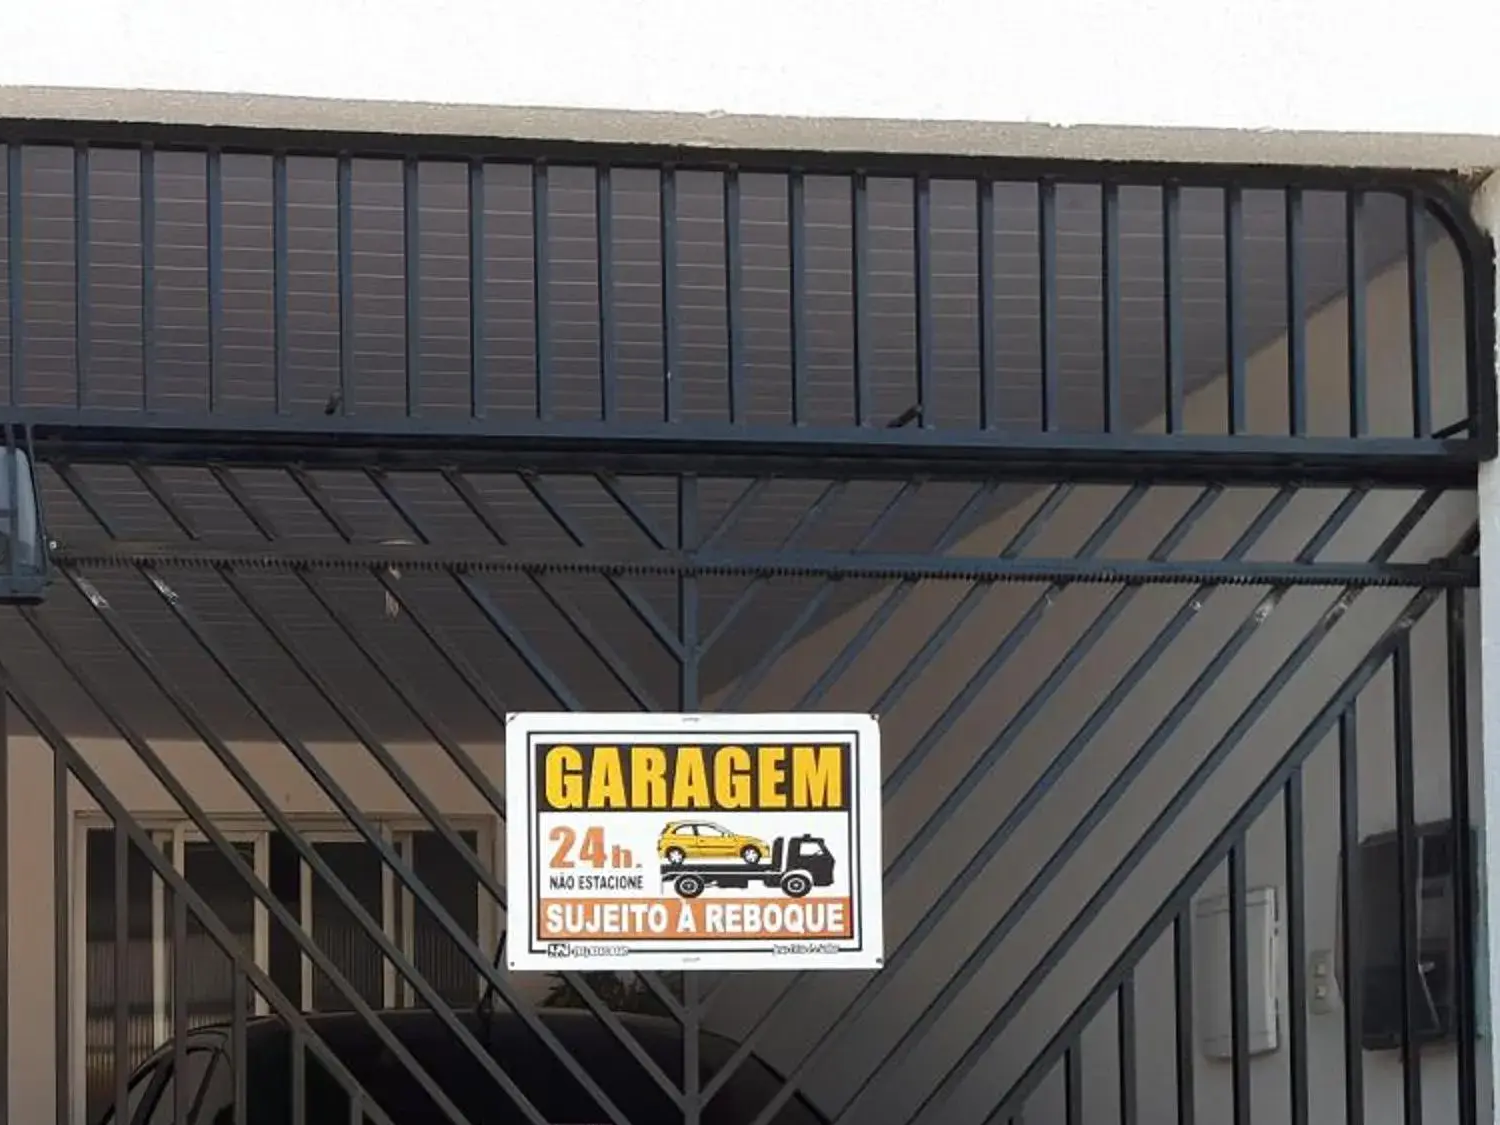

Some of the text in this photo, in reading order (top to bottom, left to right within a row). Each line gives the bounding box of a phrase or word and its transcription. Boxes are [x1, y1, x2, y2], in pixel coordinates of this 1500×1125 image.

[545, 744, 842, 809] GARAGEM
[549, 826, 642, 869] 24h.
[578, 875, 644, 890] ESTACIONE
[546, 904, 668, 933] SUJEITO
[705, 903, 844, 935] REBOQUE
